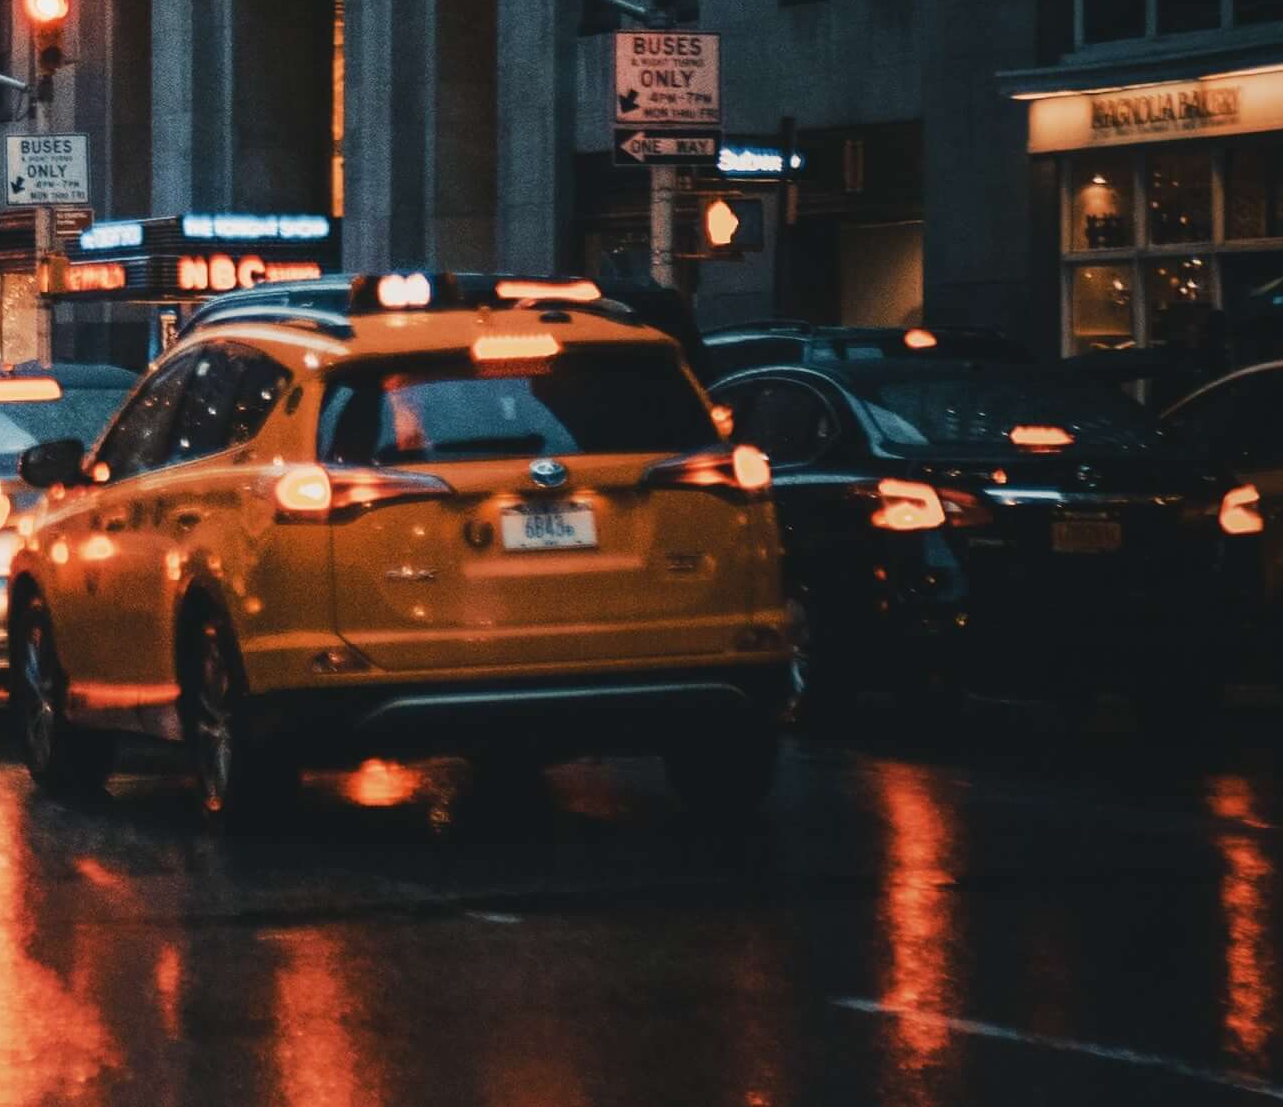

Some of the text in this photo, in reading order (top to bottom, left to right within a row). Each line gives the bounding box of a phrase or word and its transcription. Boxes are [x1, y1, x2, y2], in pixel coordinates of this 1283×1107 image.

[633, 36, 702, 55] BUSES
[641, 70, 694, 87] ONLY
[21, 140, 73, 153] BUSES
[630, 139, 708, 153] ONE WAY
[27, 164, 68, 178] ONLY
[178, 253, 266, 290] NBC
